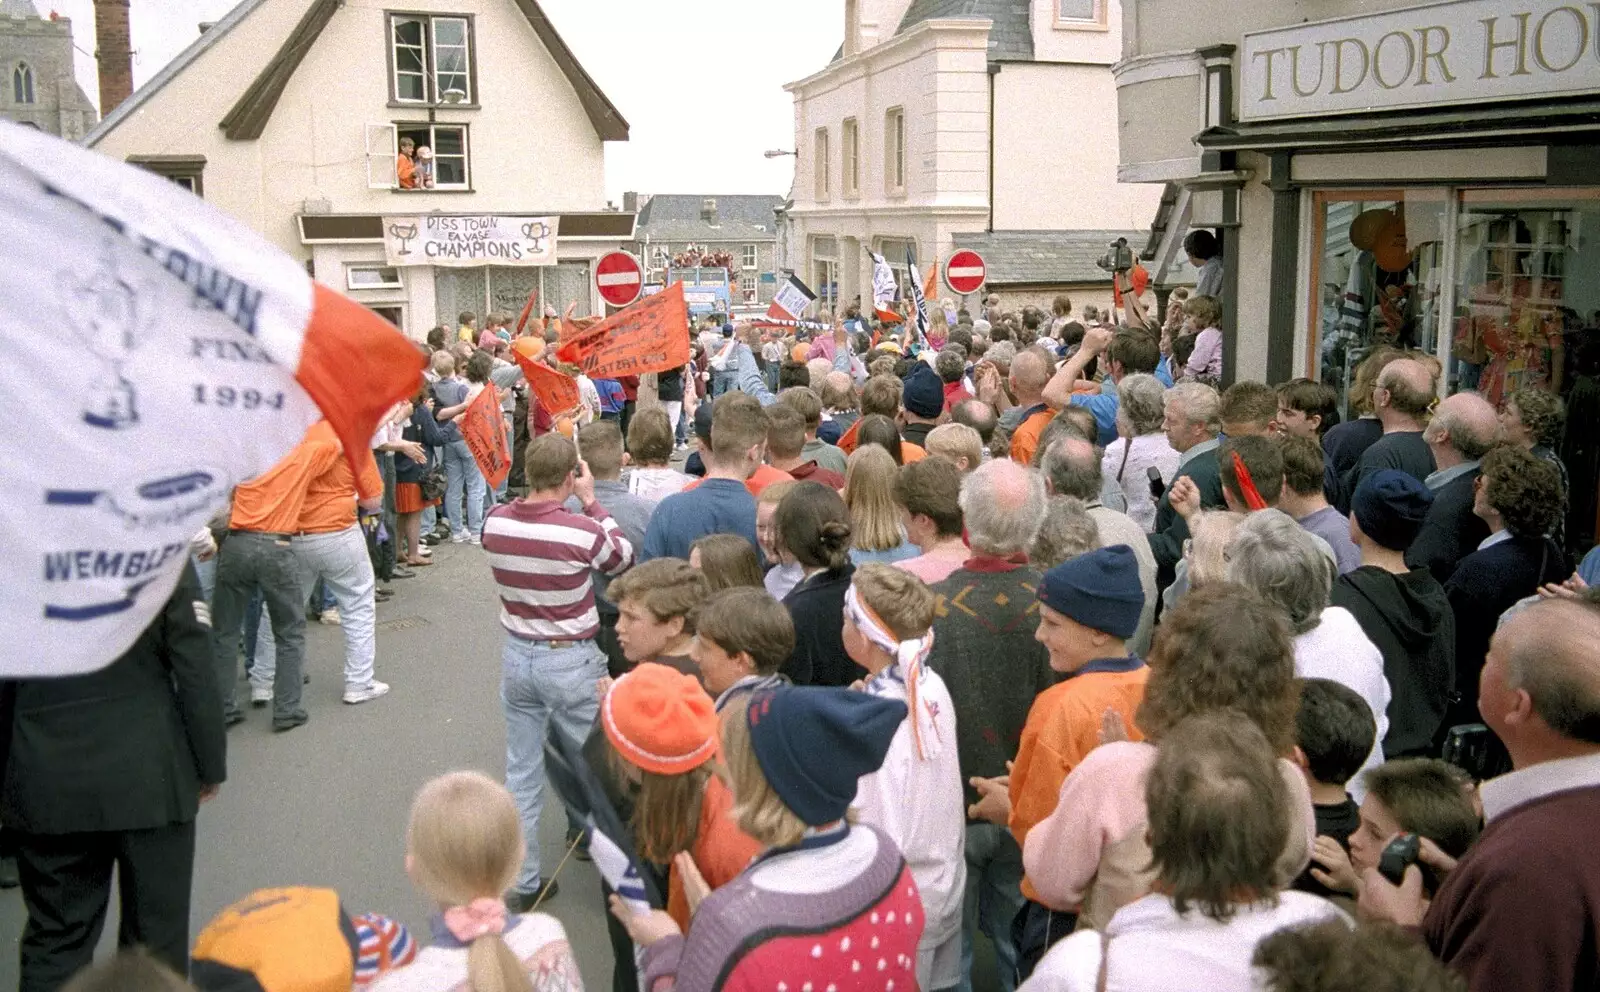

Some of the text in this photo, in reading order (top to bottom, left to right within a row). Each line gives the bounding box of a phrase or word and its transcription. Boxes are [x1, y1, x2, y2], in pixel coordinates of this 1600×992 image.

[1252, 4, 1600, 101] TUDOR HO
[426, 216, 498, 231] DISS TOWN
[463, 230, 491, 242] VASE
[424, 240, 522, 260] CHAMPIONS
[194, 383, 284, 410] 1994
